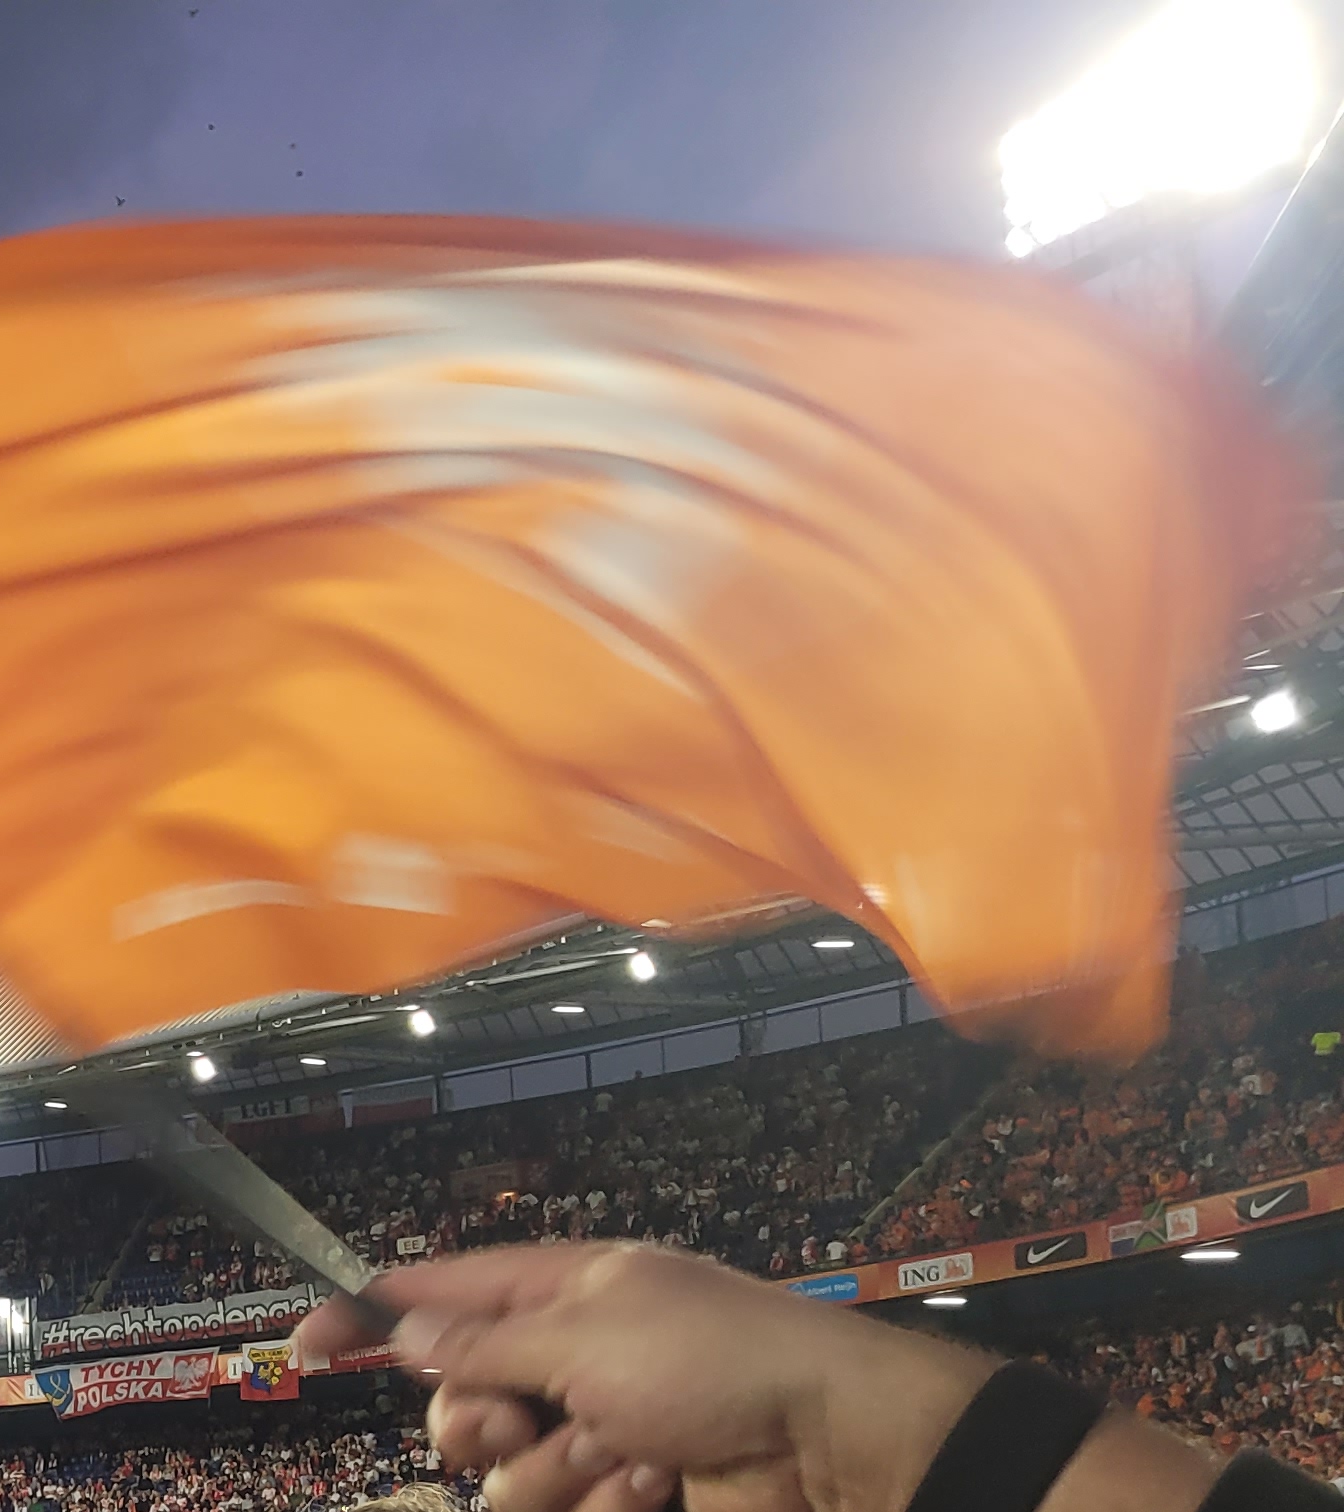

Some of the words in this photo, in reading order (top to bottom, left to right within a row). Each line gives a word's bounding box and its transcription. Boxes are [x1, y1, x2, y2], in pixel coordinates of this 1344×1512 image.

[403, 1240, 420, 1252] EE
[902, 1265, 940, 1287] ING
[80, 1359, 163, 1384] TYCHY
[78, 1381, 164, 1412] POLSKA
